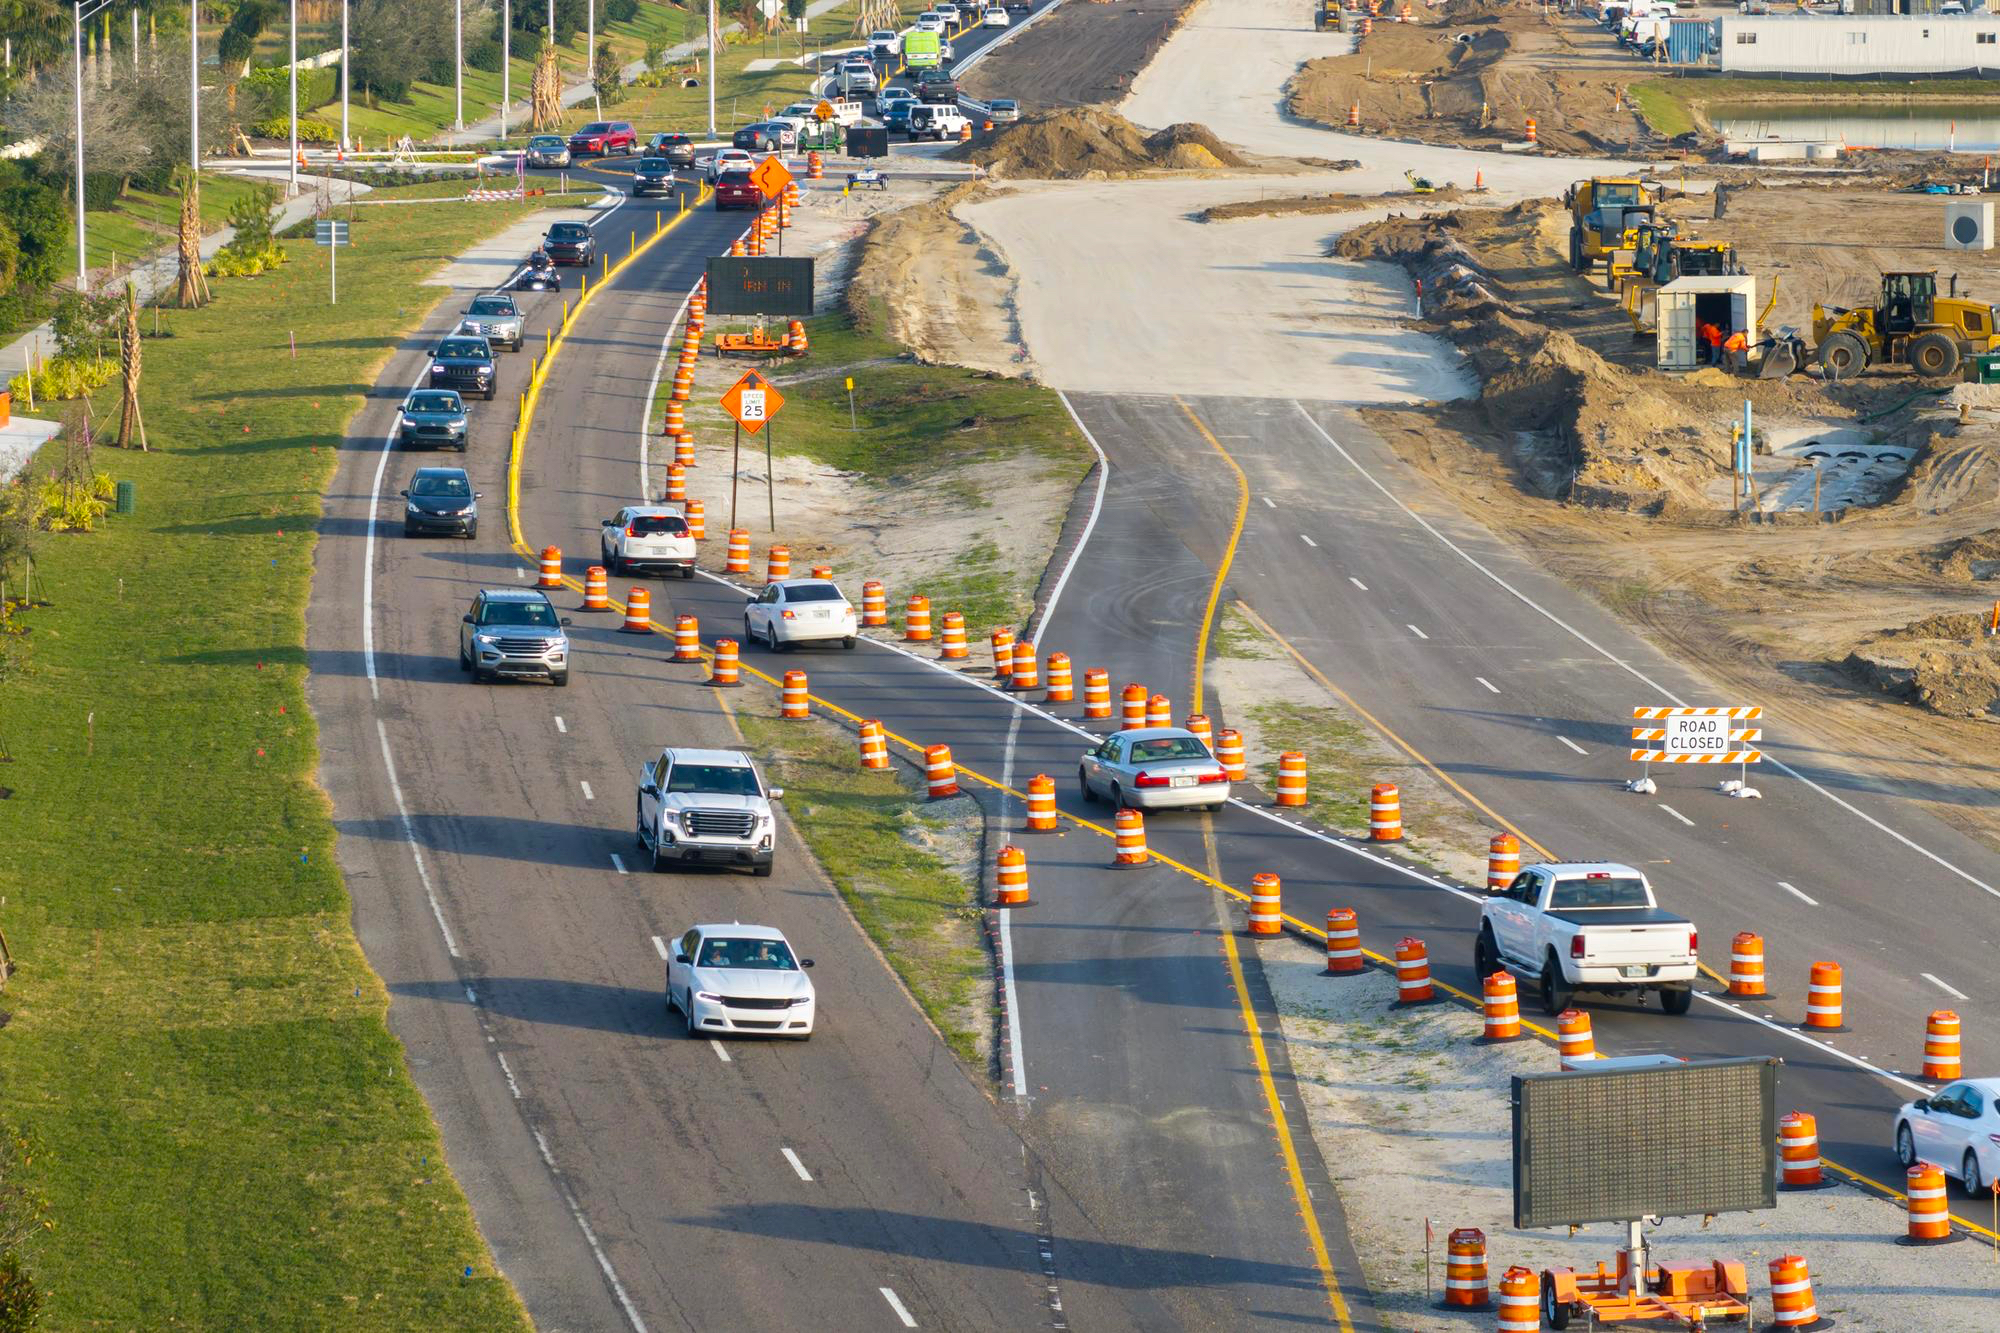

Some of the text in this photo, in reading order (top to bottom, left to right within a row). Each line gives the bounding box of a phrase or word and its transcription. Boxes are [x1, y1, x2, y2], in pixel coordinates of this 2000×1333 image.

[744, 405, 763, 416] 25
[1679, 720, 1717, 733] ROAD
[1671, 736, 1724, 749] CLOSED
